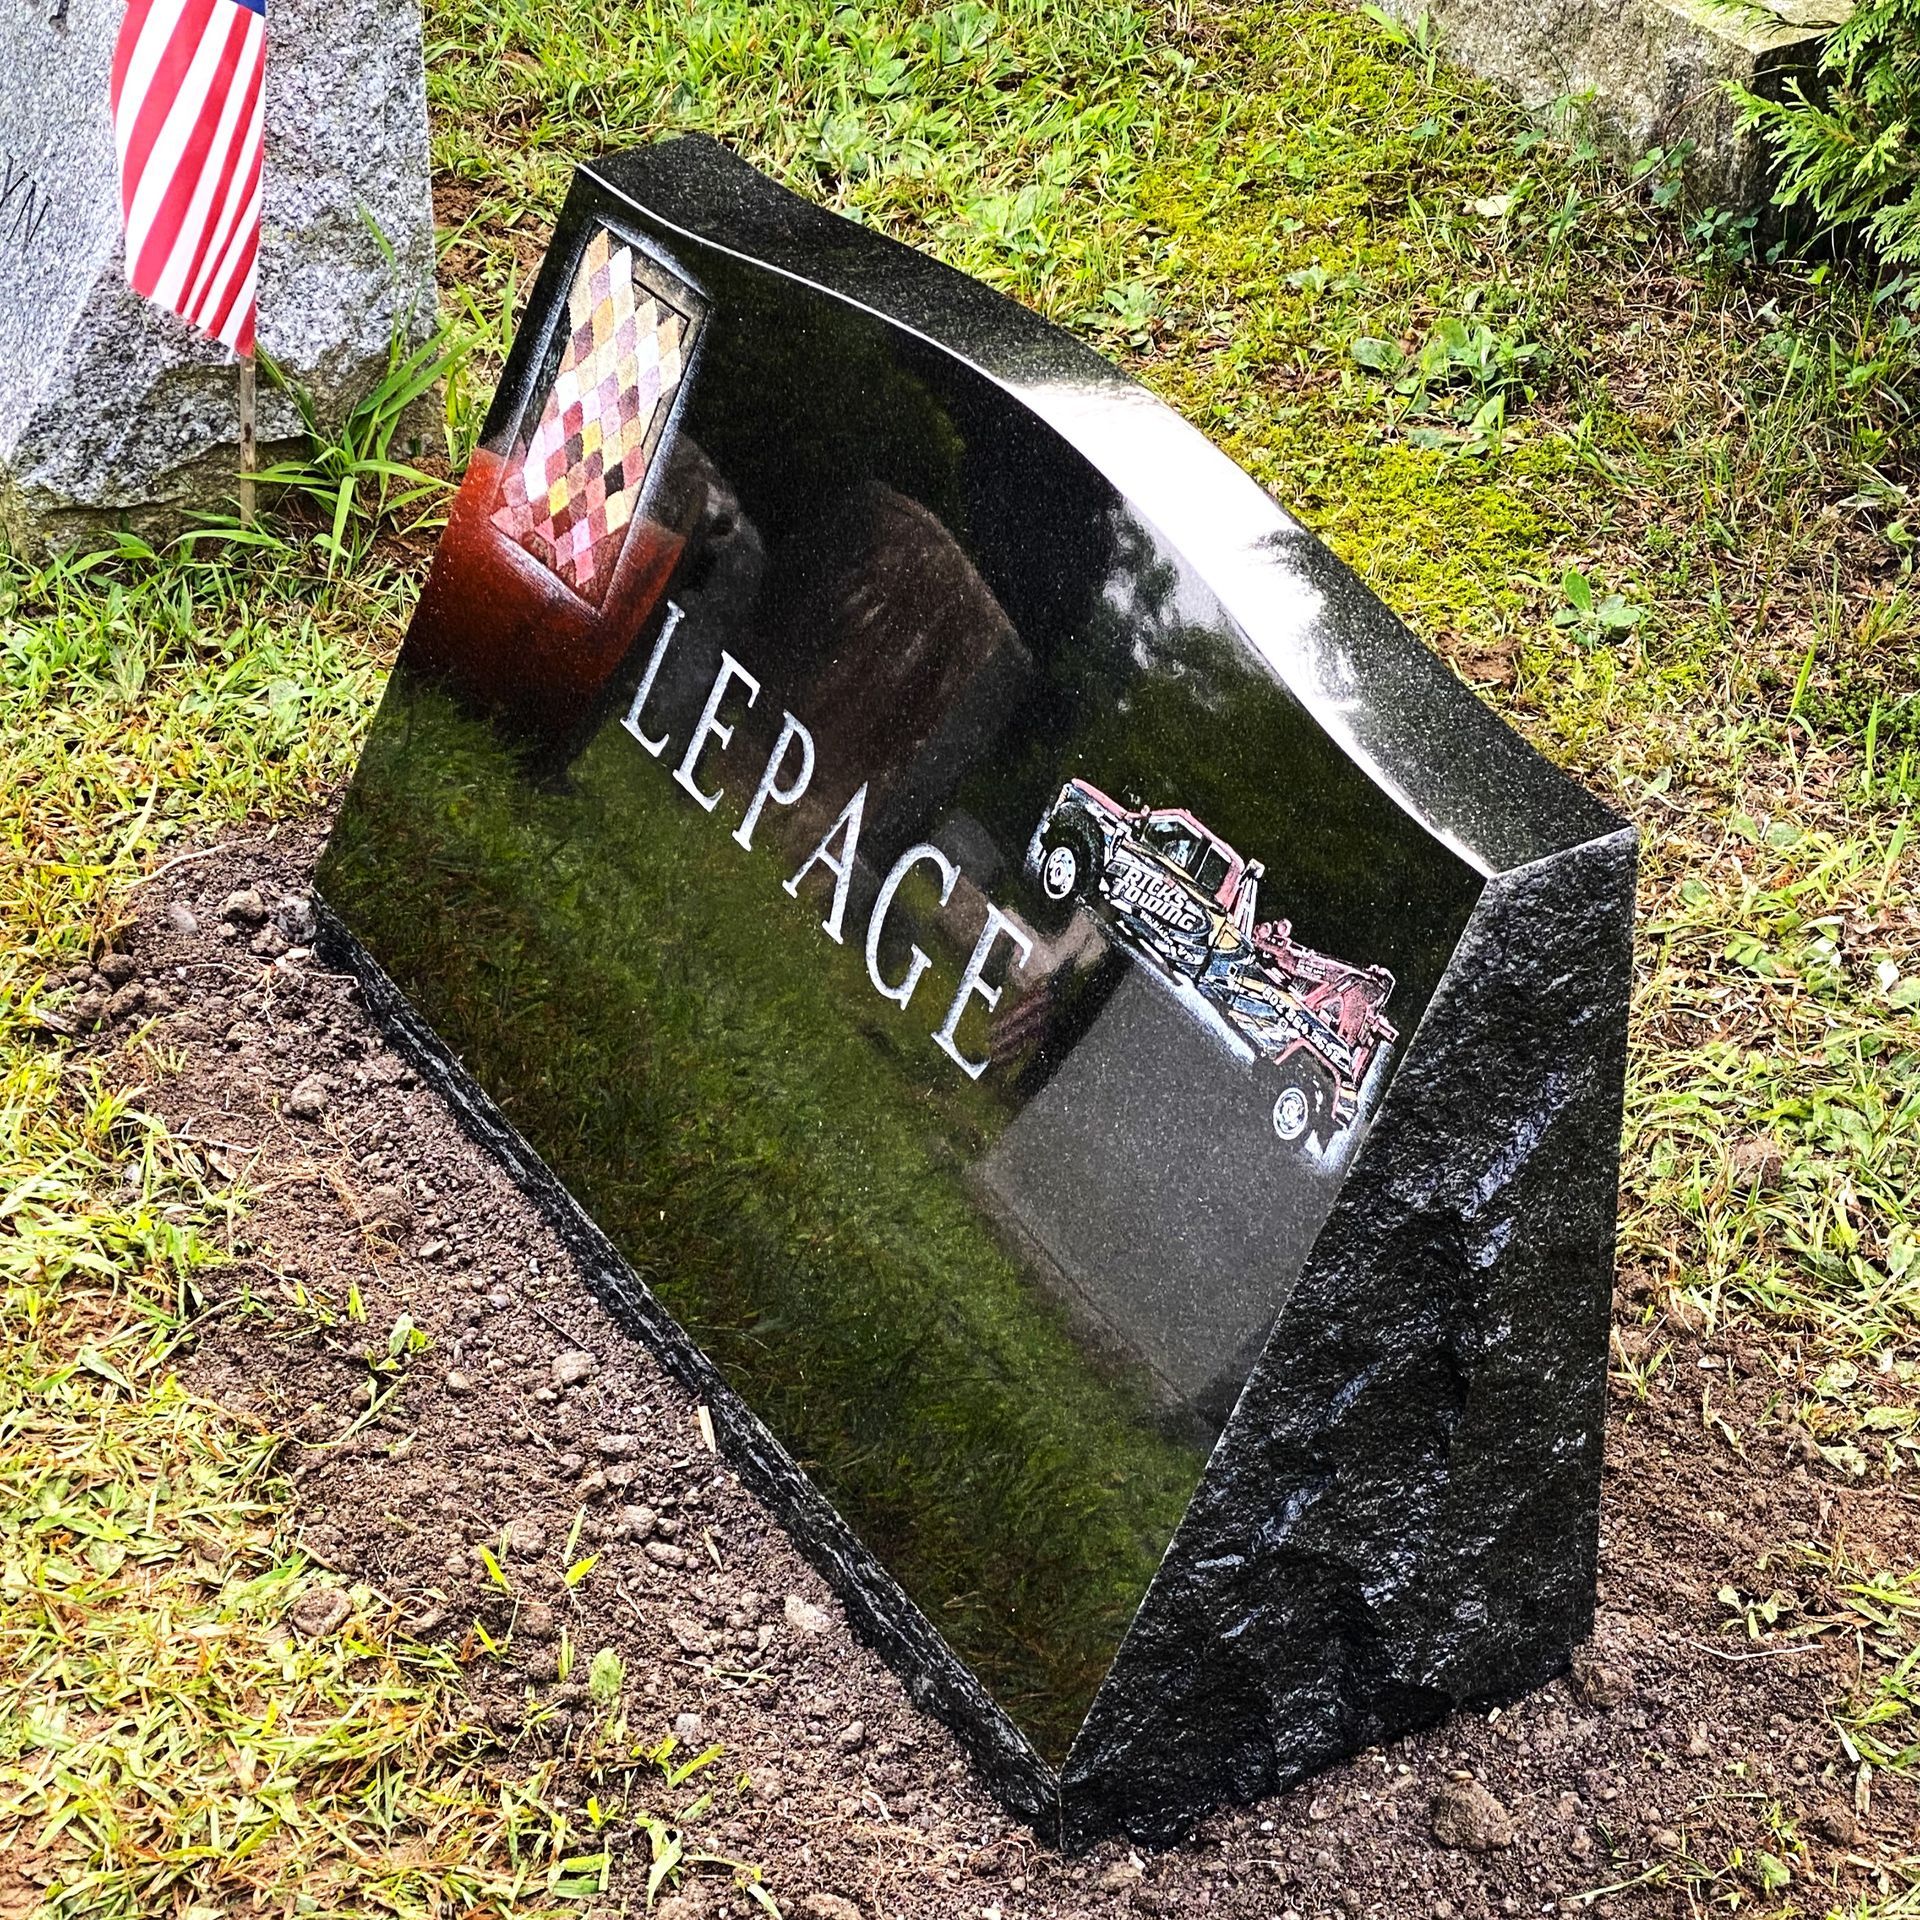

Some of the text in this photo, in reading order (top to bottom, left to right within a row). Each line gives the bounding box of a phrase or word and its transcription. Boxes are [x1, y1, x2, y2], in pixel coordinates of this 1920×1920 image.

[619, 599, 1032, 1081] LEPAGE
[1111, 877, 1197, 931] TOWING
[1122, 866, 1188, 910] RICKS
